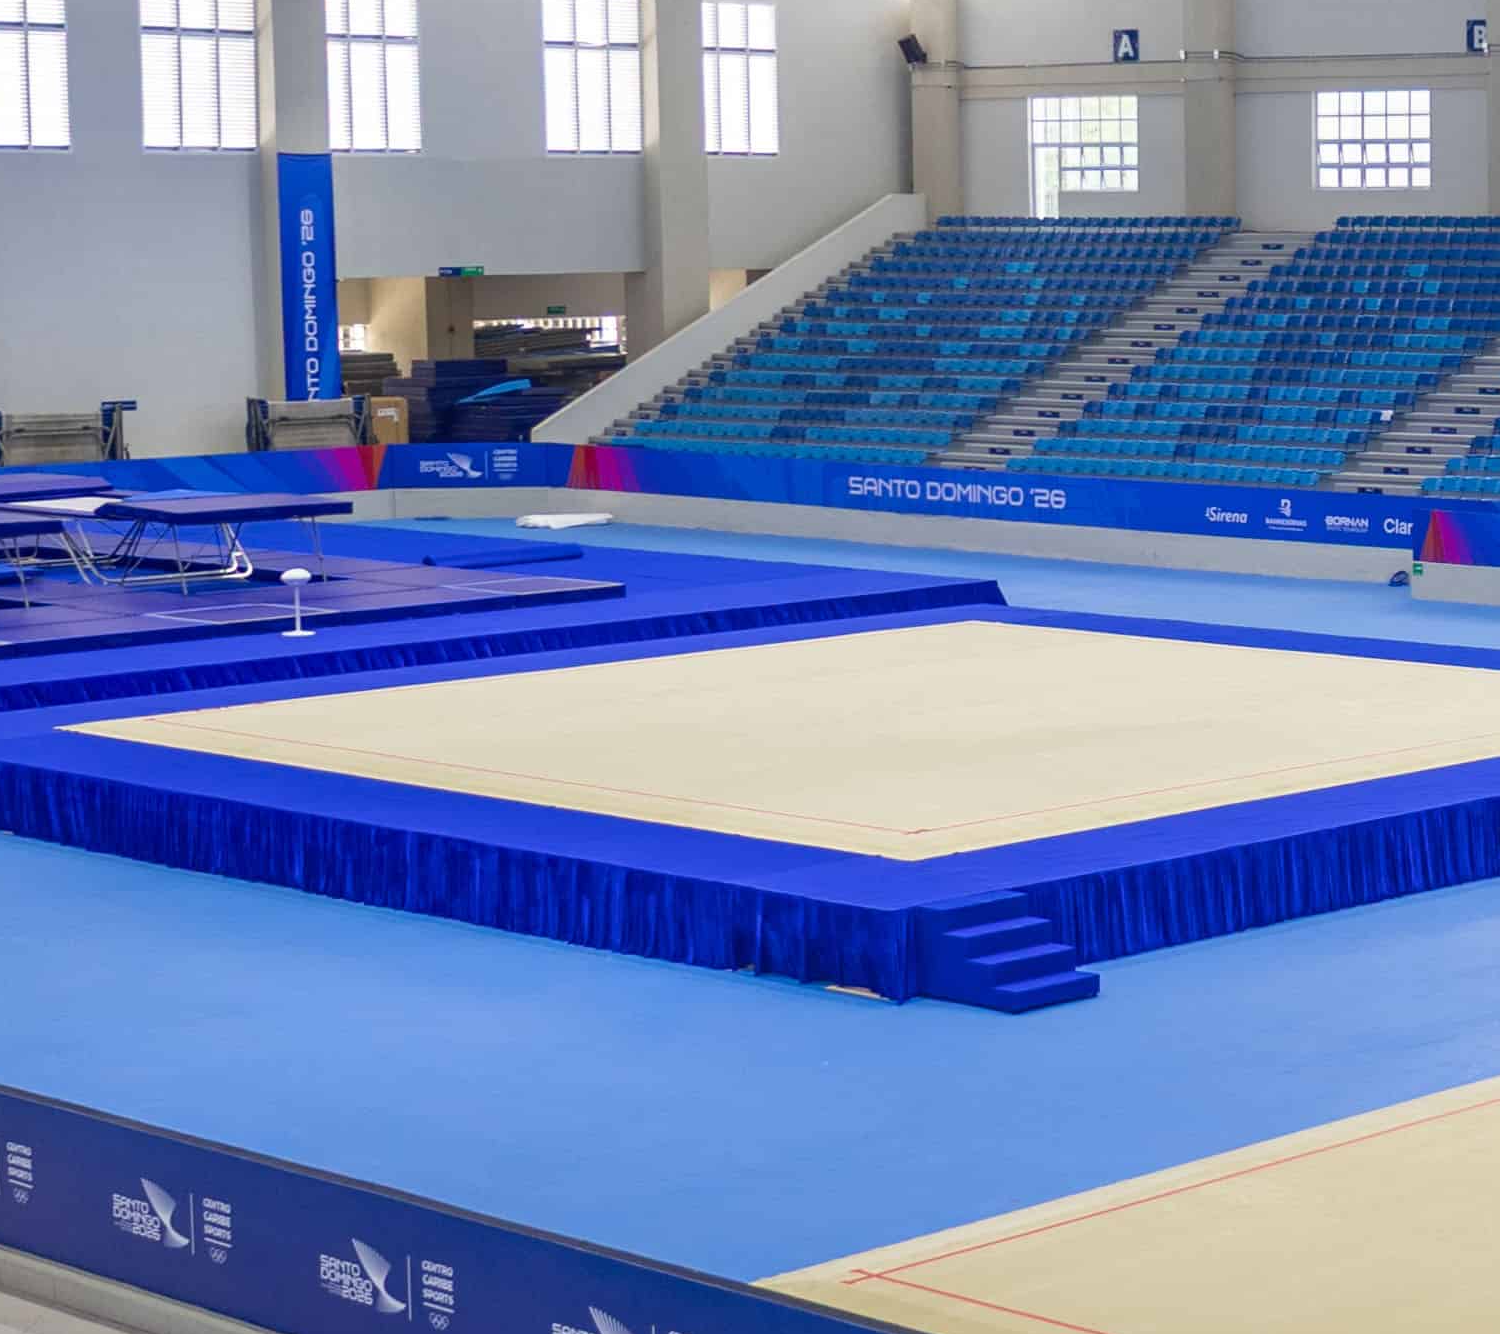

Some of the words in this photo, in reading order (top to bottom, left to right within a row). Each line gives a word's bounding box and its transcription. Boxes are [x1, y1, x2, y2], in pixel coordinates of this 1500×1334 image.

[1118, 34, 1135, 58] A
[301, 251, 319, 352] DOMINGO
[849, 476, 920, 499] SANTO
[925, 482, 1024, 506] DOMINGO
[1208, 506, 1248, 524] Sirena
[1383, 518, 1414, 536] Clar
[112, 1193, 148, 1214] SANTO
[112, 1204, 161, 1230] DOMINGO
[132, 1220, 161, 1241] 2026
[320, 1254, 360, 1276] SANTO
[320, 1267, 372, 1292] DOMINGO
[342, 1285, 373, 1306] 2026
